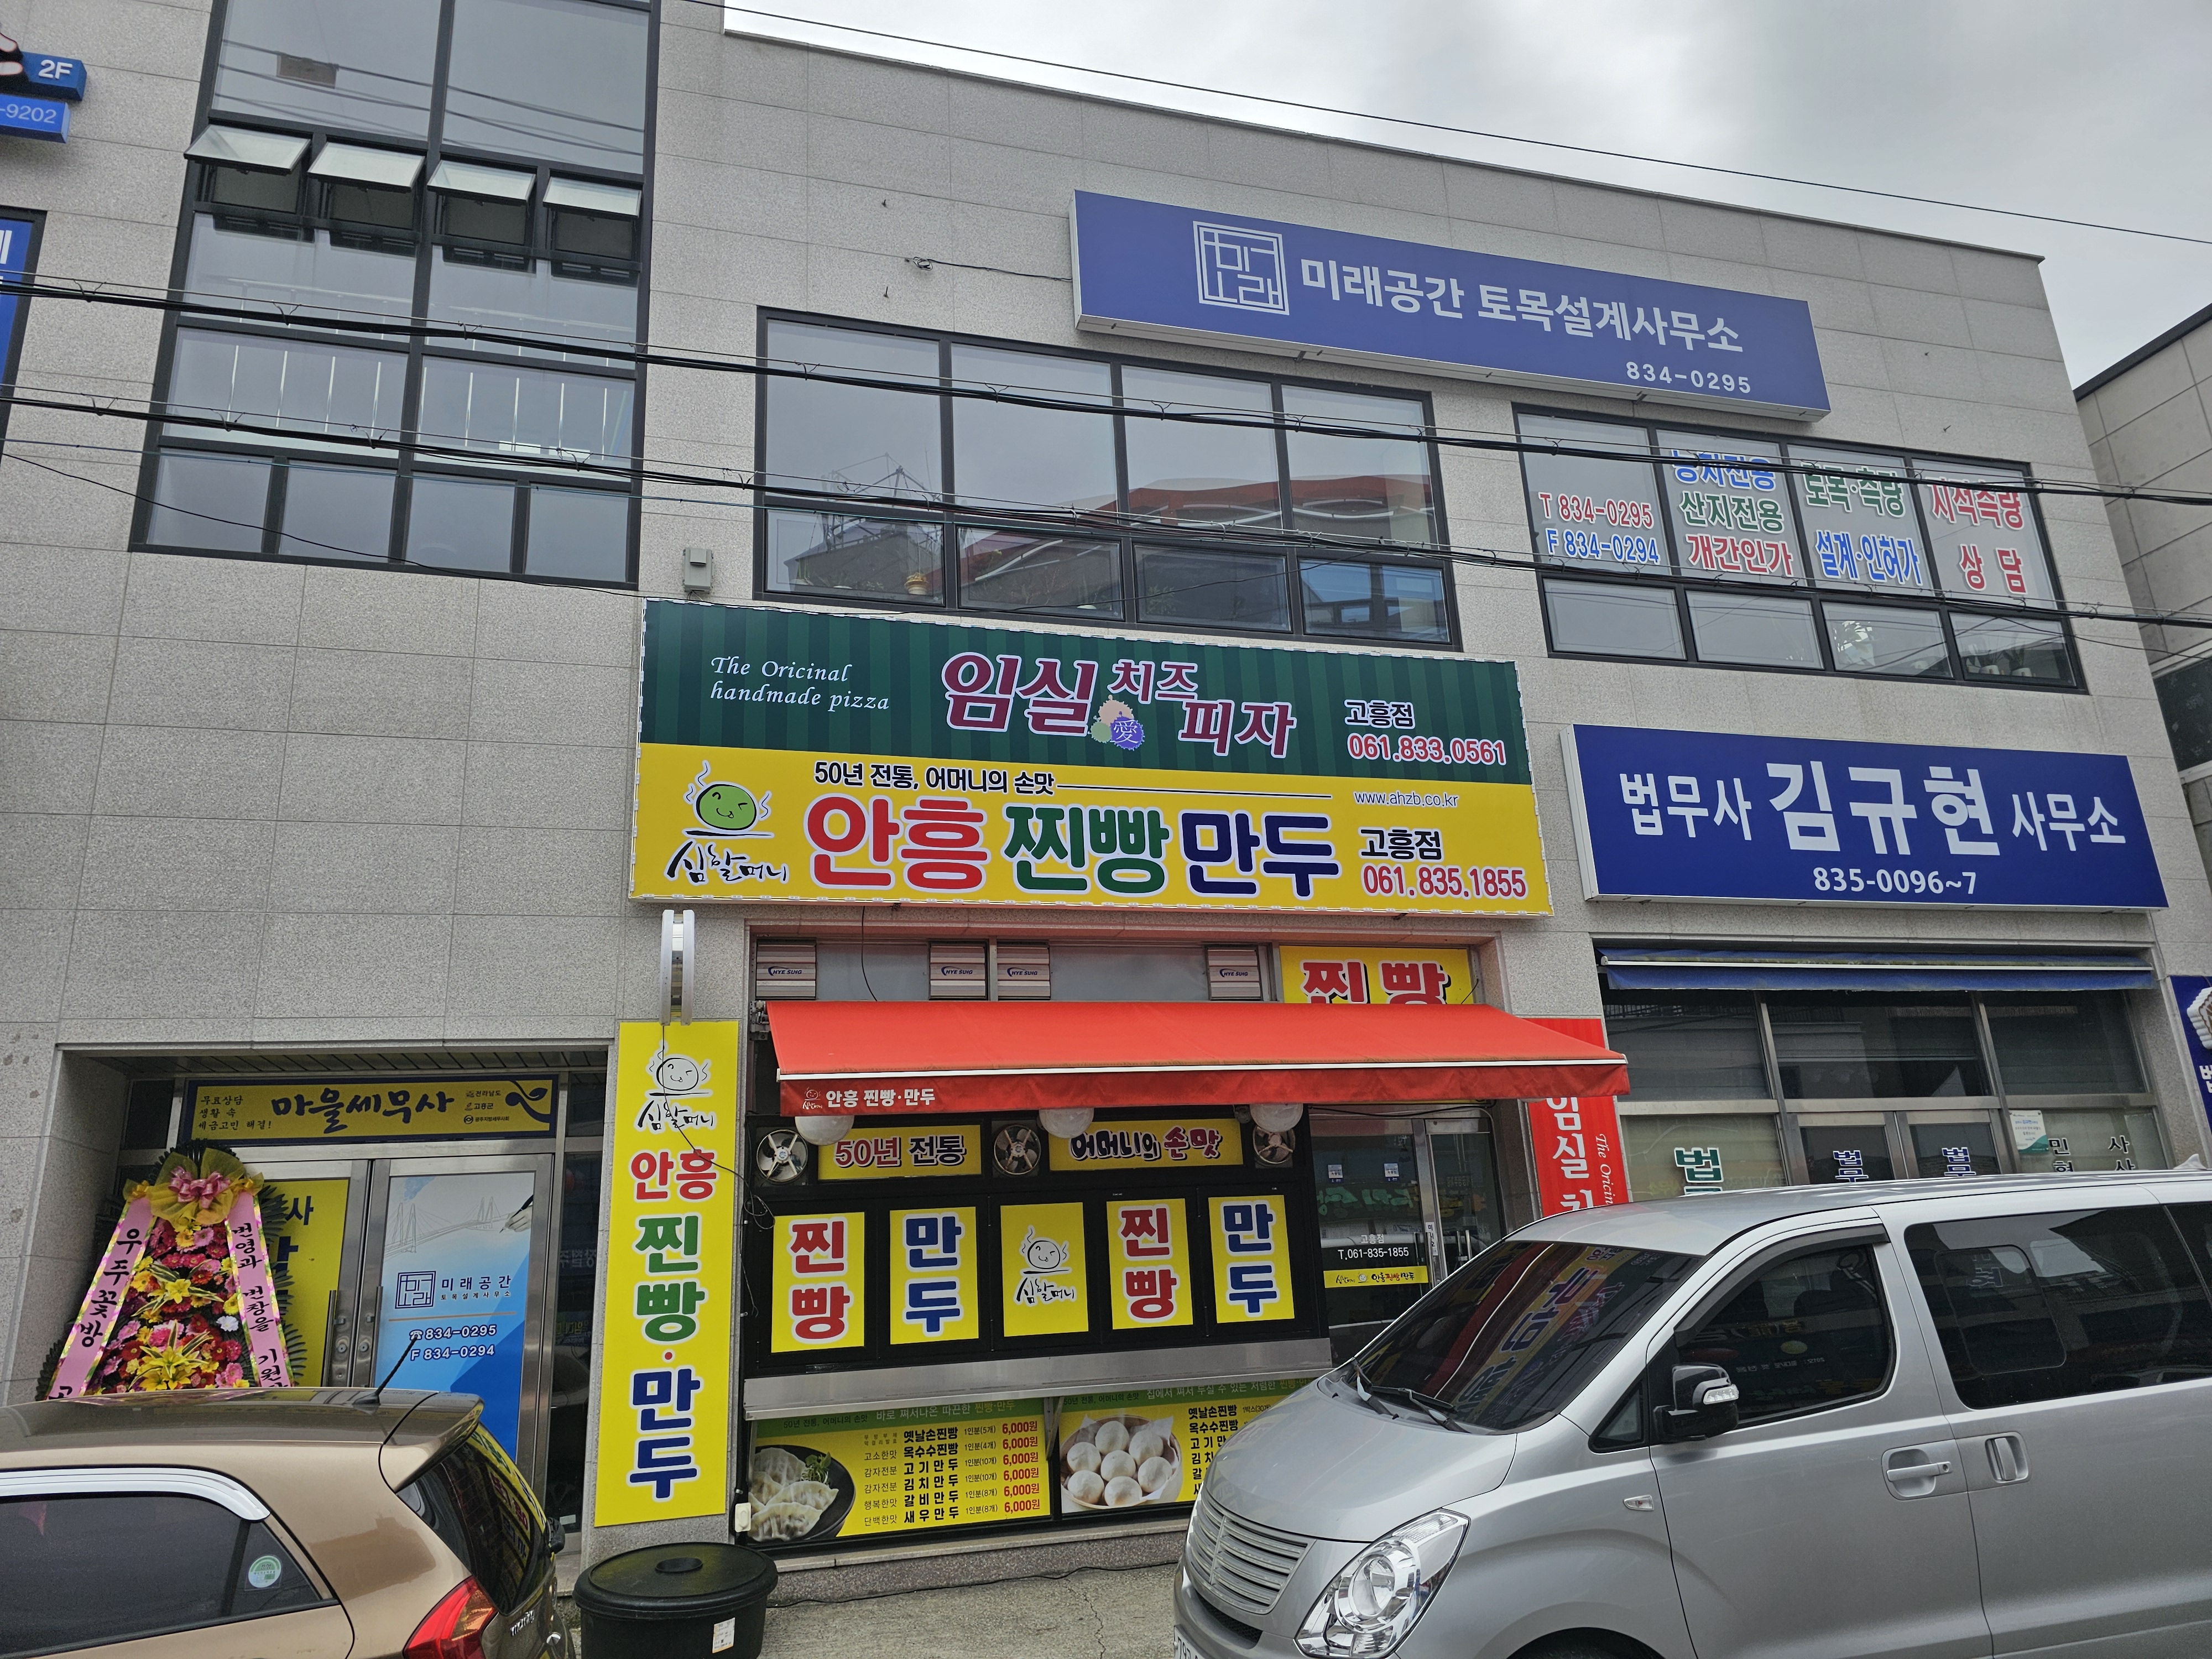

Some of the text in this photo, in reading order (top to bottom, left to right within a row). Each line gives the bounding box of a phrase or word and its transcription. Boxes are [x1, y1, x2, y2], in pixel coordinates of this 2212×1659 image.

[38, 59, 73, 80] 2F
[1301, 258, 1743, 353] 미래공간 토목설계사무소
[1626, 361, 1752, 394] 834-0295
[1538, 492, 1655, 529] T 834-0295
[1679, 491, 1785, 534] 산지전용
[1546, 528, 1661, 565] F 834-0294
[1686, 534, 1793, 577] 개간인가
[711, 656, 853, 683] The Oricinal
[711, 681, 890, 713] handmade pizza
[941, 651, 1198, 737] 임실 치즈
[1178, 698, 1297, 758] 피자
[1345, 700, 1414, 729] 고흥점
[1348, 734, 1507, 766] 061.833.0561
[814, 761, 1055, 796] 50년 전통, 어머니의 손맛
[1354, 791, 1459, 808] www.ahzb.co.kr
[1619, 760, 2126, 855] 법무사 김규현 사무소
[805, 793, 1342, 900] 안흥 찐빵 만두
[1358, 826, 1444, 860] 고흥점
[1361, 864, 1528, 900] 061.835.1855
[1813, 867, 1978, 895] 835-0096~7
[200, 1108, 236, 1118] 생활 속
[201, 1095, 244, 1105] 무료상담
[270, 1087, 455, 1135] 마을세무사
[826, 1090, 859, 1108] 안흥
[199, 1120, 272, 1130] 세금고민 해결!
[834, 1134, 967, 1168] 50년 전통
[1069, 1125, 1223, 1161] 어머니의 손맛
[1595, 1134, 1609, 1158] The
[629, 1149, 718, 1201] 안흥
[1674, 1147, 1723, 1195] 법
[231, 1223, 263, 1270] 번영과
[1360, 1234, 1384, 1244] 고흥점
[1119, 1204, 1180, 1322] 찐빵
[1222, 1201, 1280, 1316] 만두
[1338, 1247, 1409, 1260] T.061-835-1855
[441, 1275, 512, 1291] 미래공간
[788, 1218, 852, 1343] 찐빵
[904, 1213, 964, 1337] 만두
[242, 1285, 275, 1333] 번창을
[440, 1290, 510, 1301] 토목설계사무소
[425, 1324, 497, 1340] 834-0295
[411, 1344, 495, 1360] F 834-0294
[257, 1348, 289, 1387] 기원
[1099, 1394, 1124, 1402] 어머니의
[1127, 1392, 1139, 1401] 손맛
[1146, 1388, 1172, 1399] 집에서
[784, 1420, 800, 1428] 50년
[822, 1415, 851, 1426] 어머니의
[854, 1414, 868, 1423] 손맛
[877, 1410, 896, 1421] 바로
[942, 1403, 971, 1416] 따끈한
[1188, 1405, 1237, 1420] 옛날손찐빵
[904, 1420, 1037, 1443] 옛날손찐빵 1인분(5개) 6,000원
[1190, 1419, 1238, 1434] 옥수수찐빵
[864, 1436, 1038, 1461] 고소한맛 옥수수찐빵 1인분(4개) 6,000원
[1191, 1435, 1233, 1449] 고기만
[864, 1465, 897, 1478] 감자전분
[965, 1457, 997, 1467] 1인분(10개)
[1003, 1452, 1039, 1467] 6,000원
[864, 1482, 897, 1494] 감자전분
[966, 1472, 997, 1483] 1인분(10개)
[1003, 1468, 1039, 1482] 6,000원
[864, 1498, 897, 1510] 행복한맛
[966, 1488, 998, 1499] 1인분(8개)
[1004, 1483, 1039, 1498] 6,000원
[966, 1505, 998, 1515] 1인분(8개)
[1004, 1499, 1040, 1514] 6,000원
